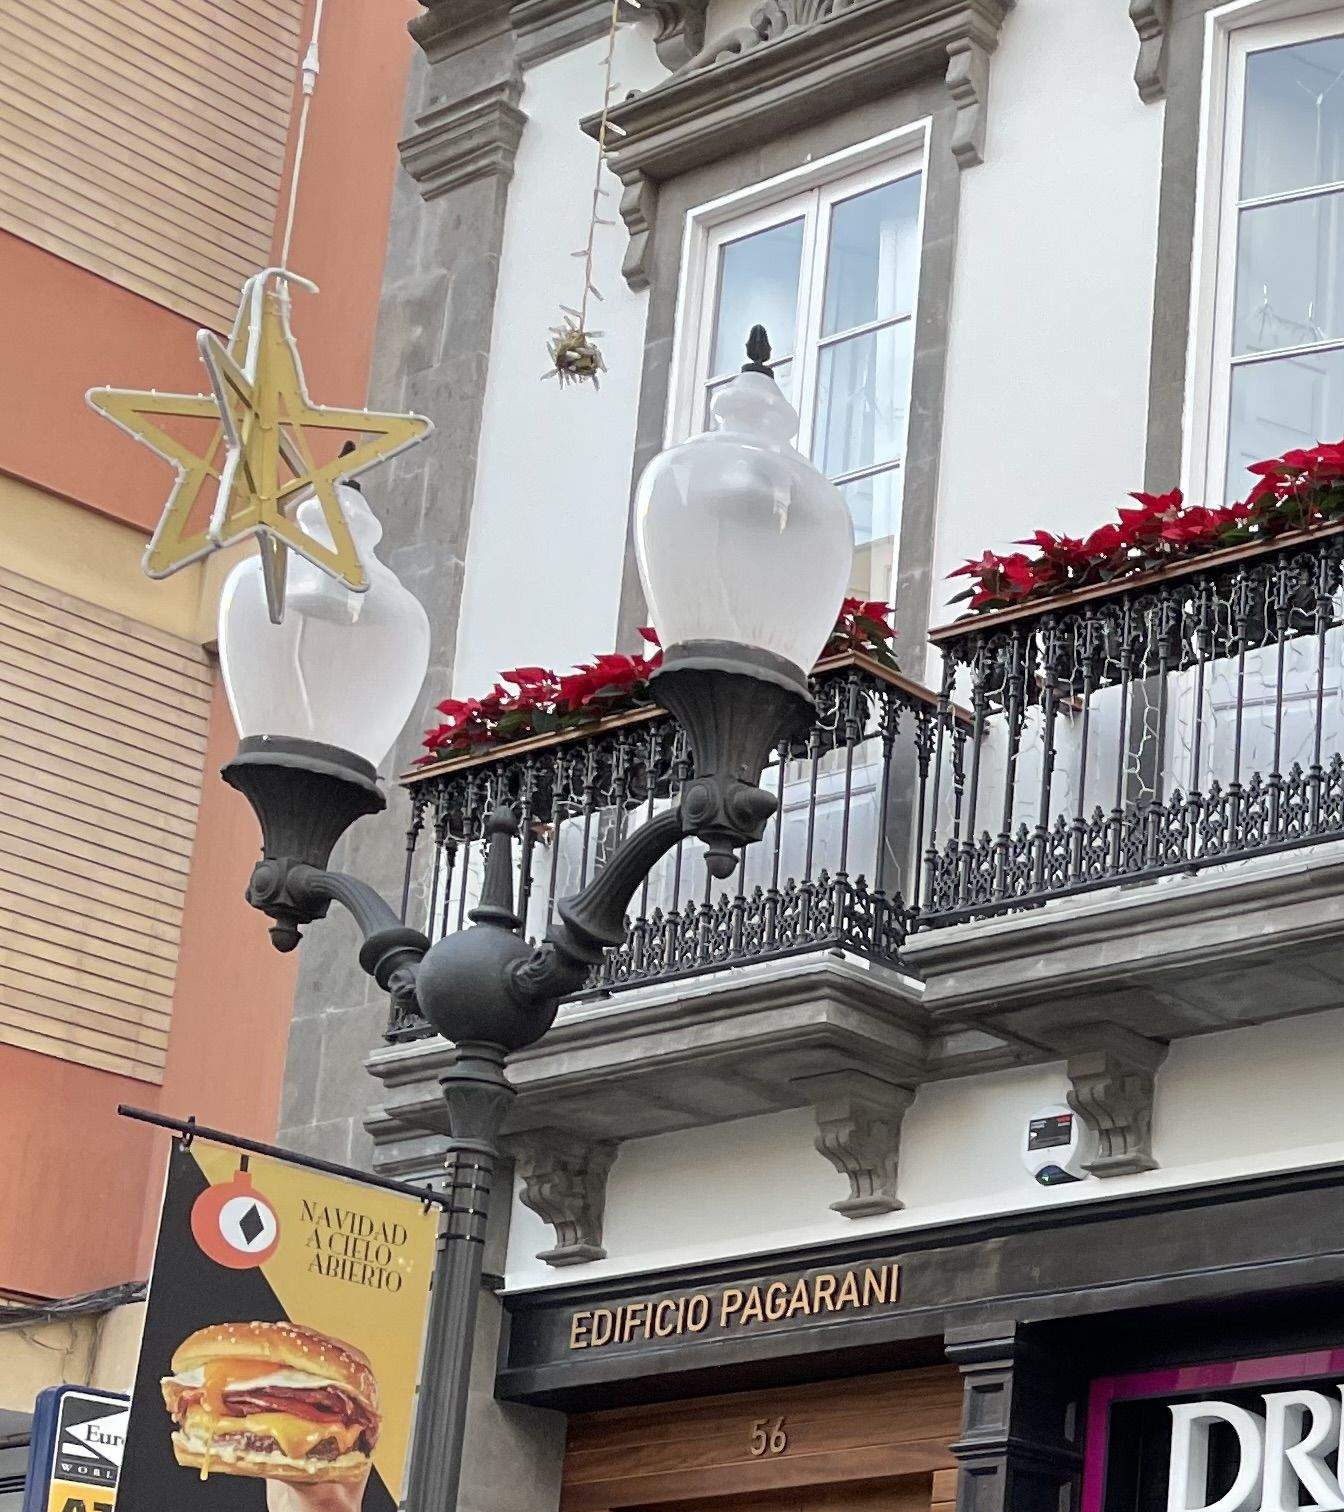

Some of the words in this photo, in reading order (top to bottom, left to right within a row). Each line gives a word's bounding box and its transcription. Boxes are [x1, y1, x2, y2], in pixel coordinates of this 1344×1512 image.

[299, 1199, 408, 1247] NAVIDAD
[305, 1227, 321, 1250] A
[328, 1231, 392, 1267] CIELO
[307, 1252, 402, 1293] ABIERTO
[569, 1294, 711, 1350] EDIFICIO
[720, 1264, 900, 1328] PAGARANI
[86, 1424, 125, 1446] Eur
[750, 1416, 787, 1456] 56
[61, 1463, 113, 1479] WORL
